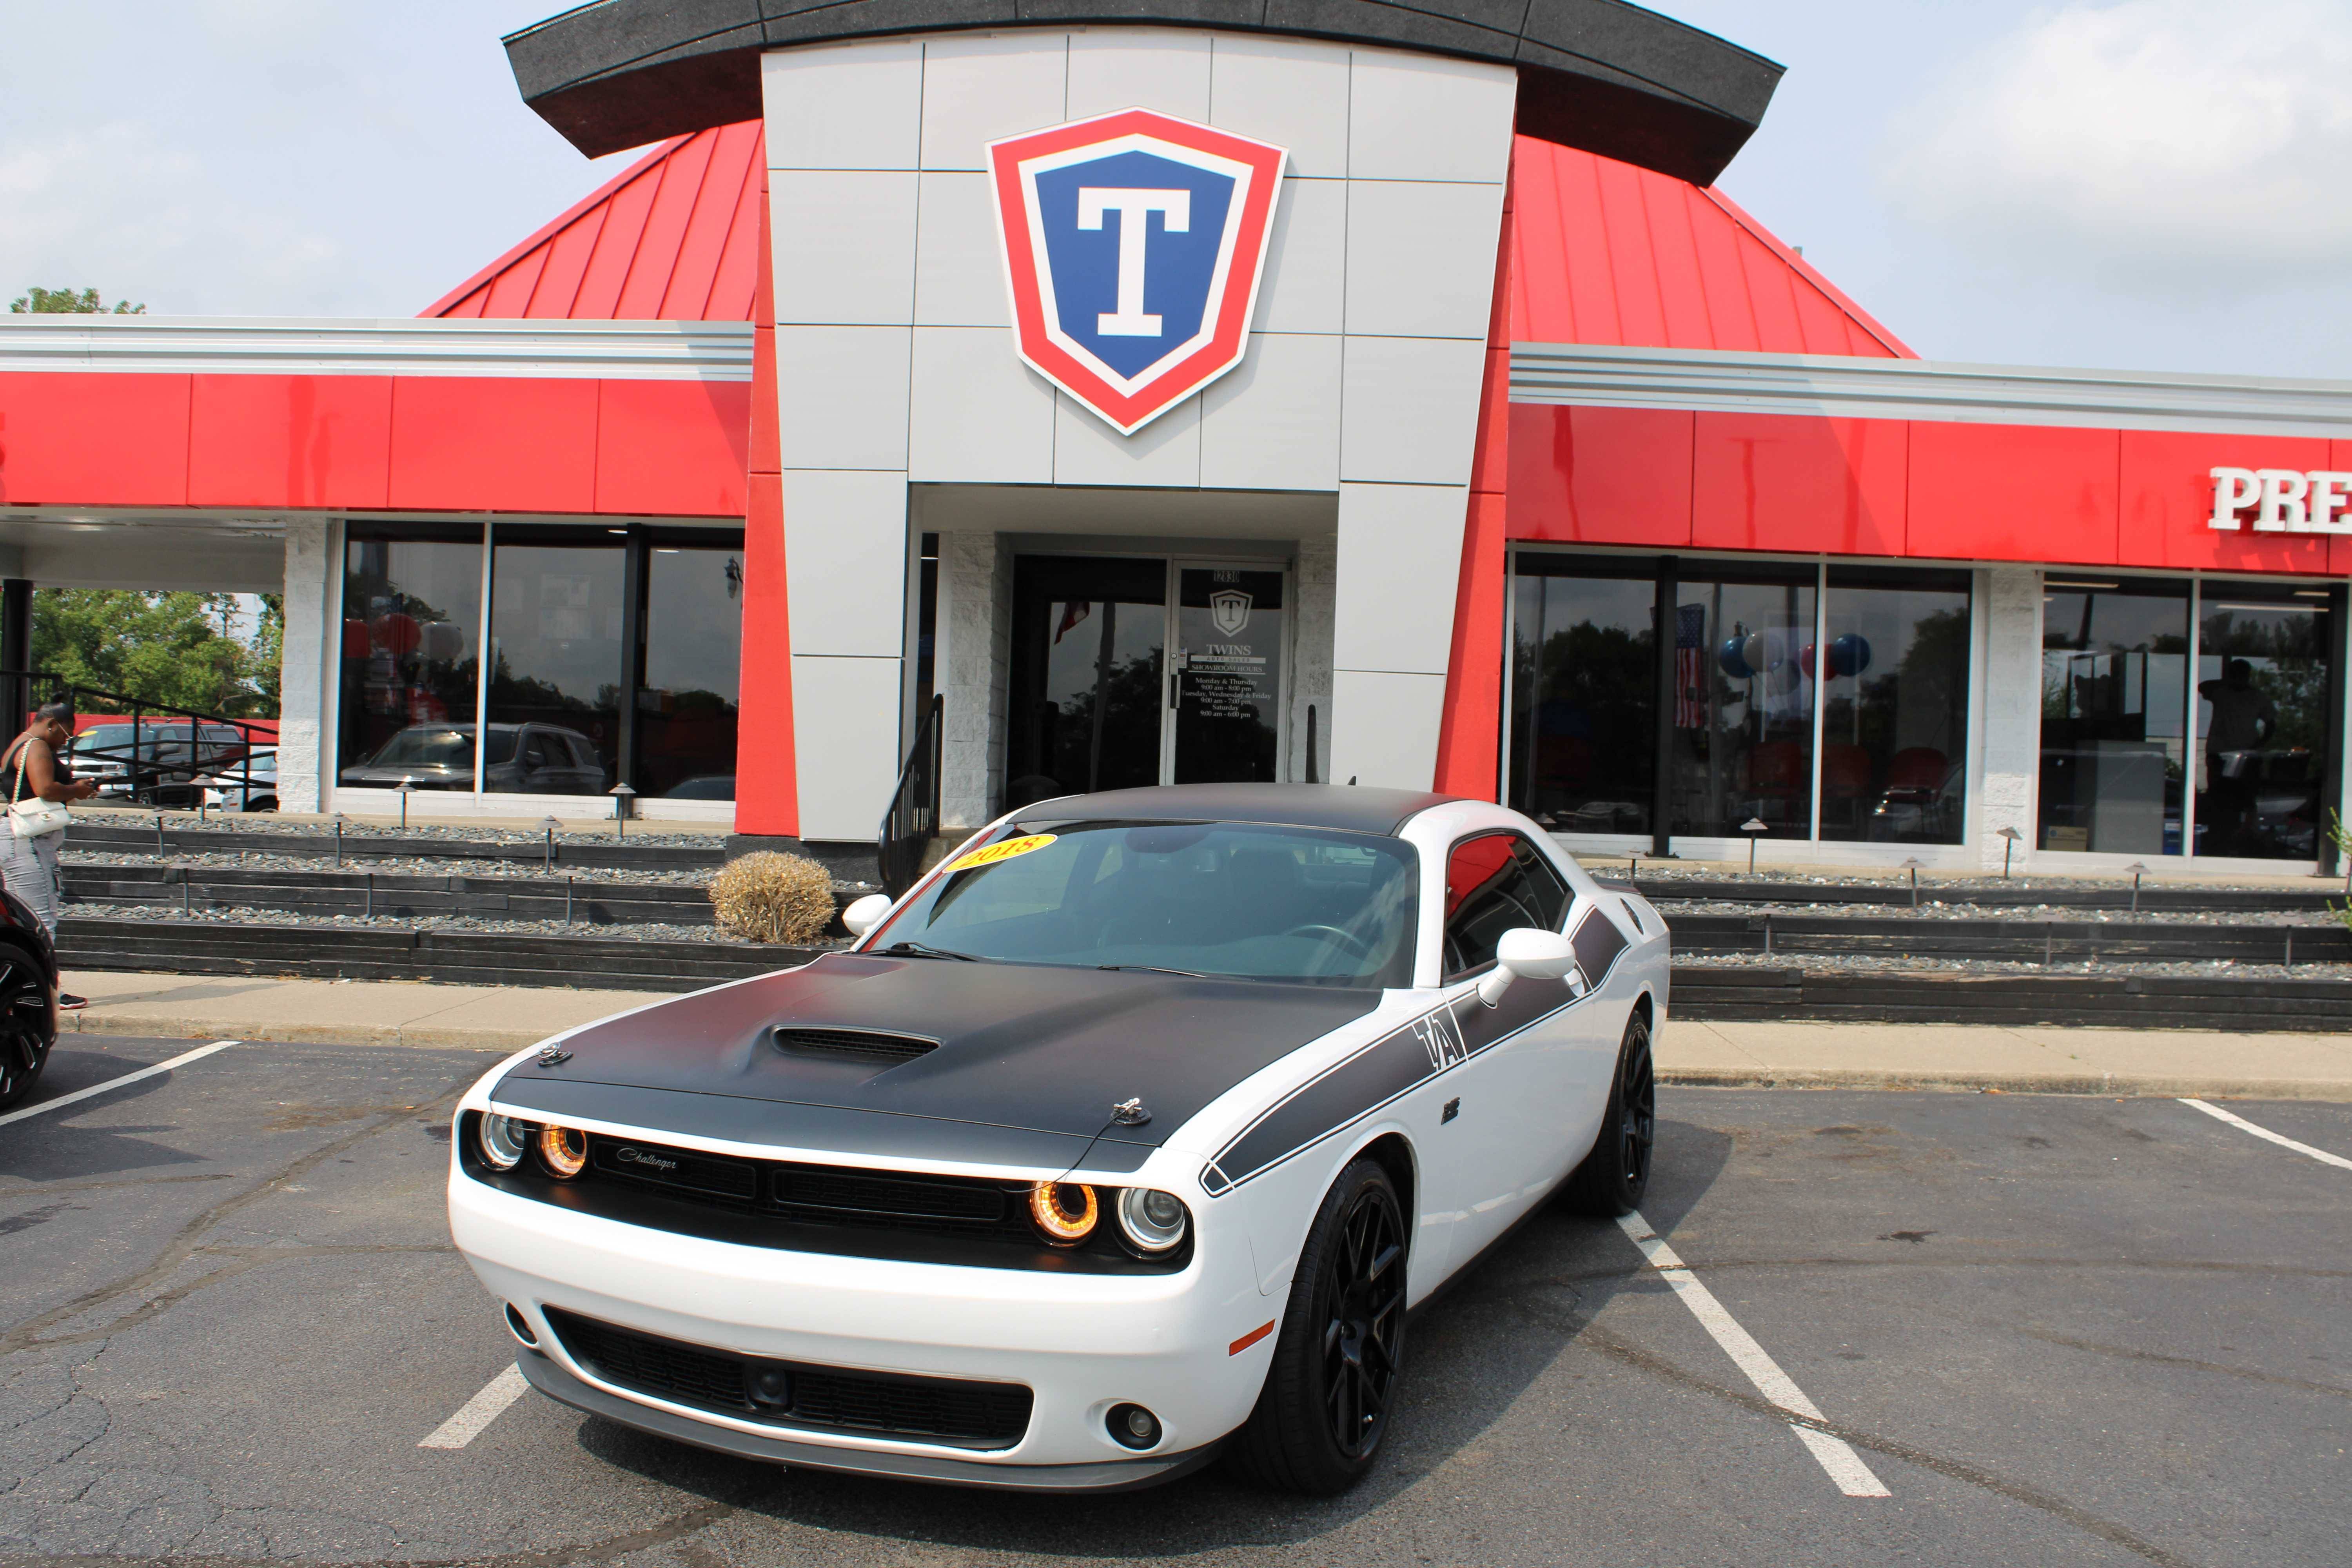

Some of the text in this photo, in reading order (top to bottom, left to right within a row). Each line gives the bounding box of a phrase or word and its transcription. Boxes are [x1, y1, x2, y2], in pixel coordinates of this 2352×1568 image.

[1078, 187, 1191, 336] T
[2208, 466, 2352, 534] PRE
[1214, 571, 1239, 582] 12830
[1221, 600, 1240, 621] T
[1206, 644, 1251, 655] TWINS
[958, 837, 1040, 867] 2018
[617, 1148, 677, 1170] Challenger
